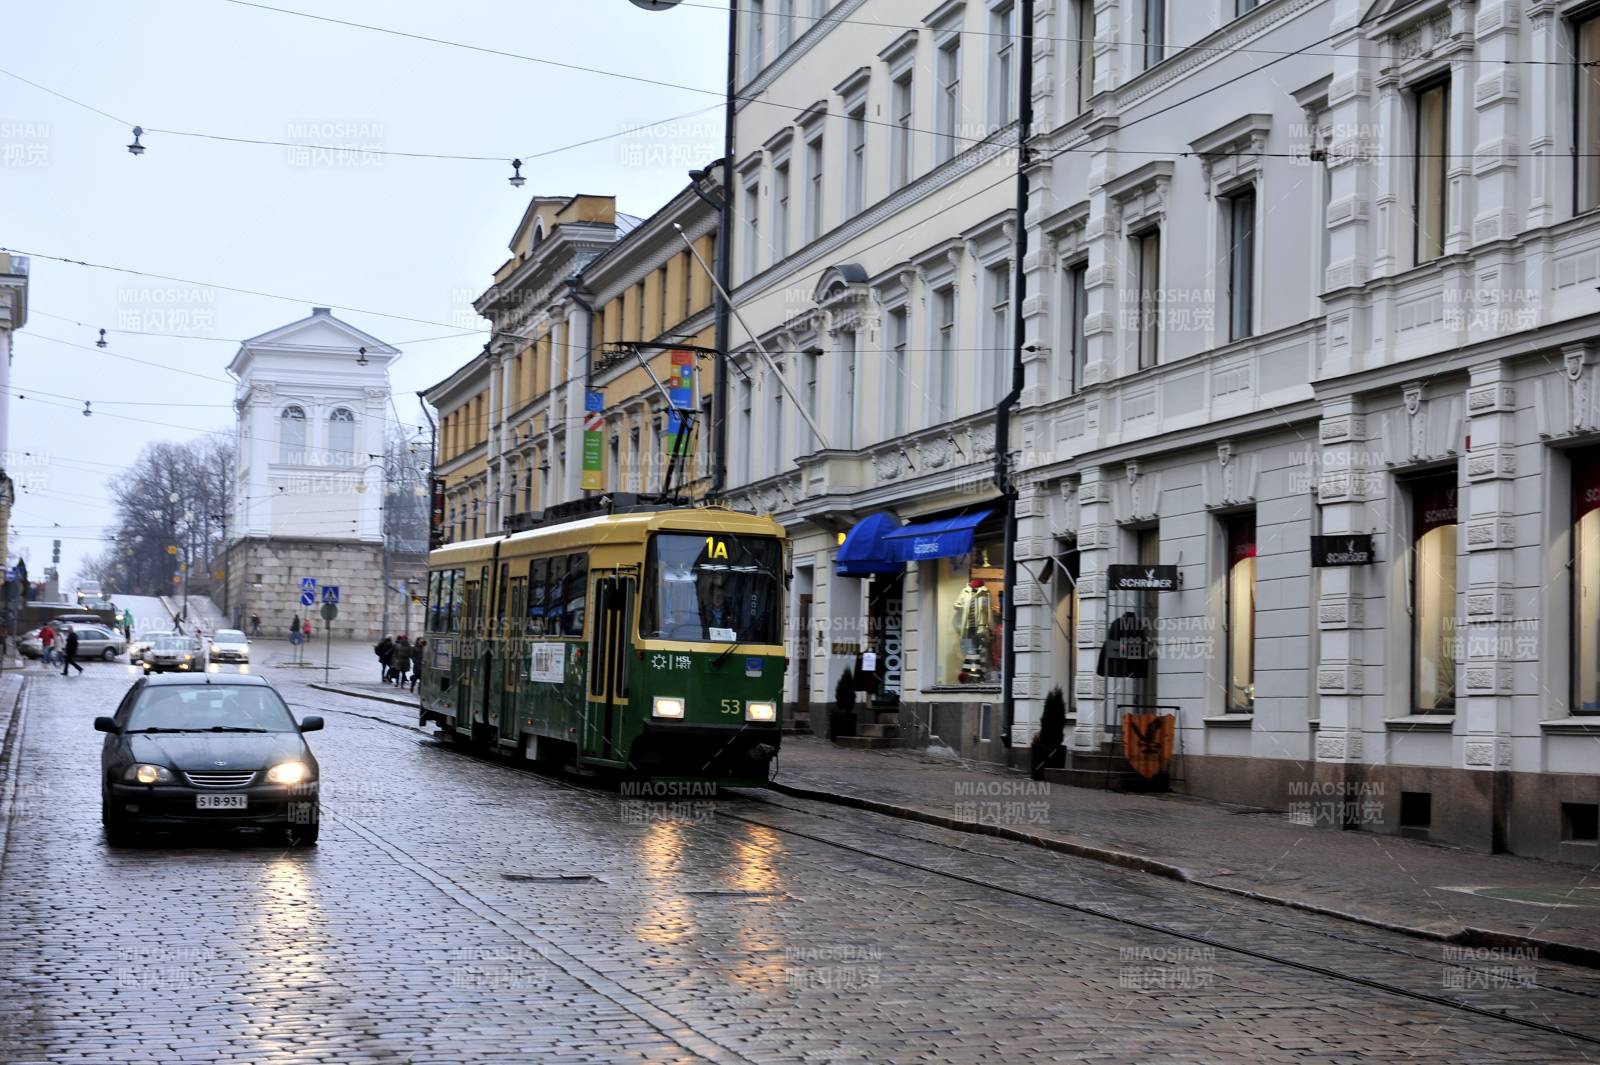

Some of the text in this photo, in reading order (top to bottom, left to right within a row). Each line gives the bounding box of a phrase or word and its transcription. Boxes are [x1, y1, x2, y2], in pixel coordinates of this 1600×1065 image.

[705, 536, 728, 559] 1A
[884, 598, 902, 696] Barbour
[675, 655, 691, 663] HSL
[720, 699, 740, 714] 53
[199, 796, 243, 807] SIB-931
